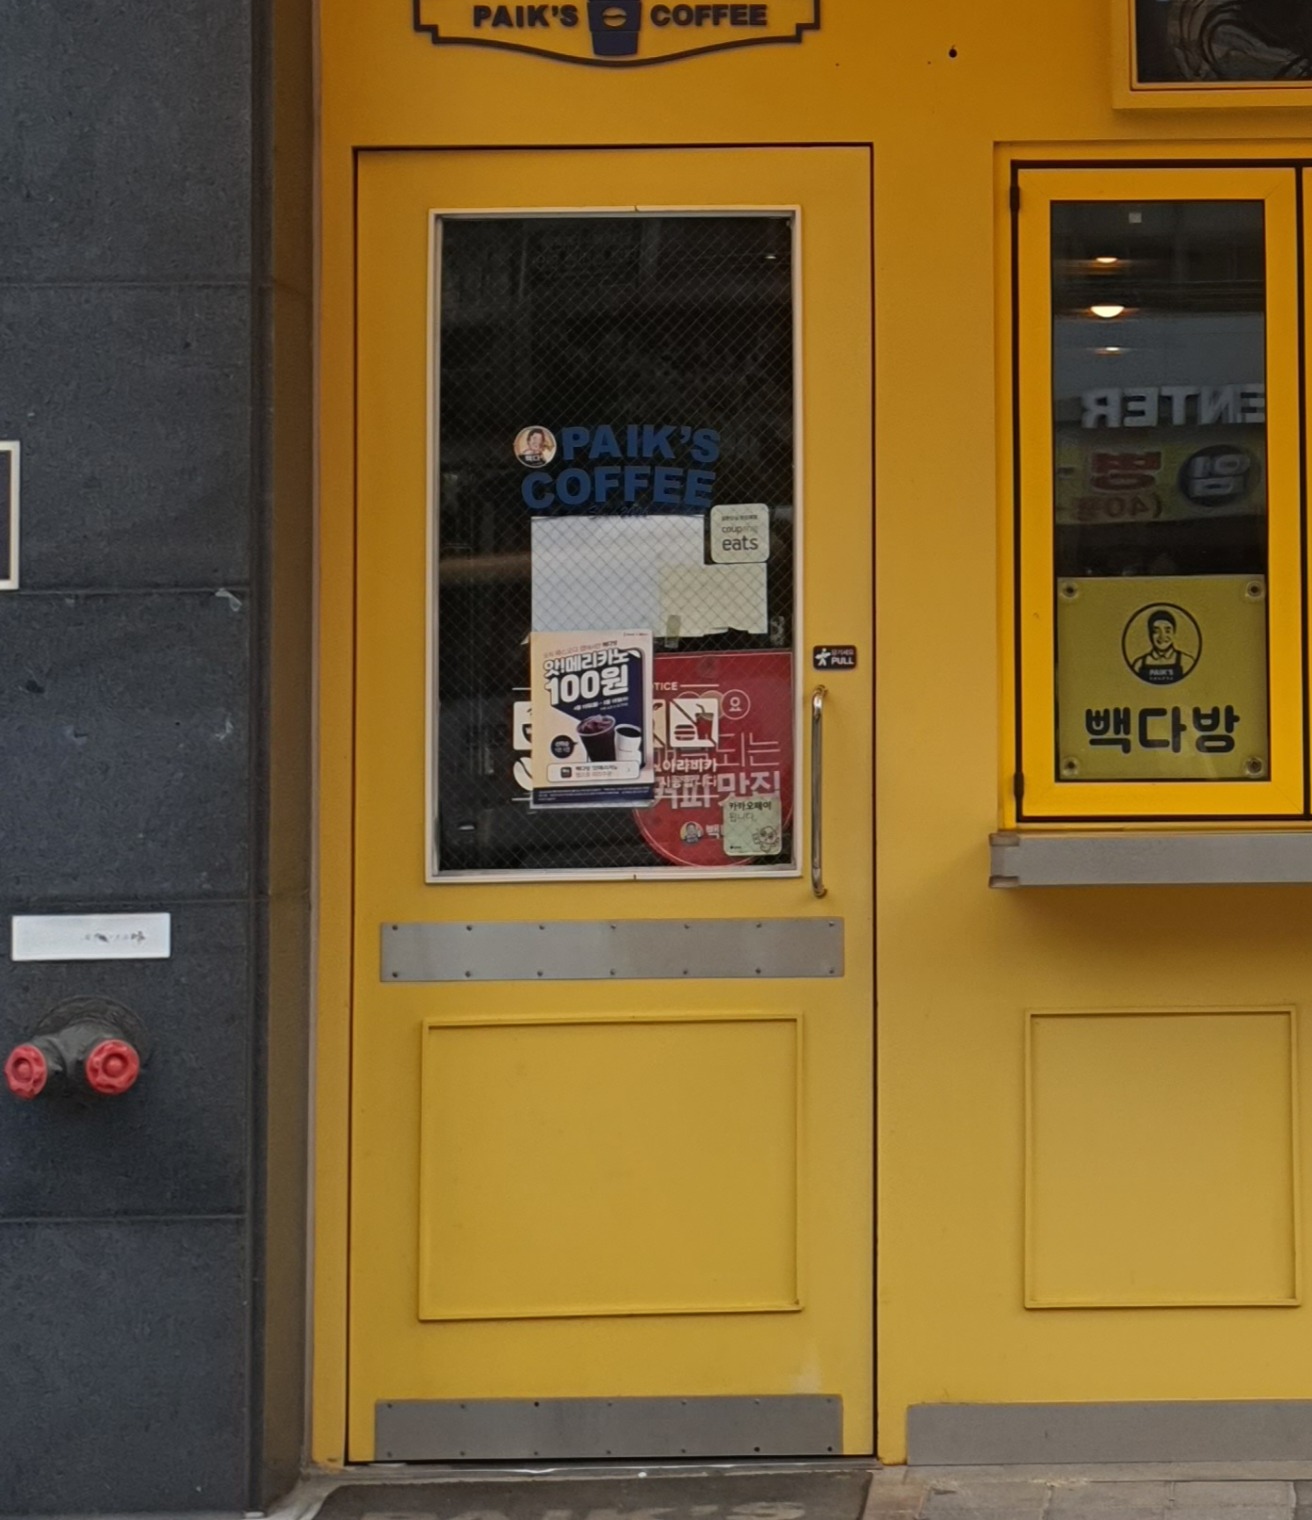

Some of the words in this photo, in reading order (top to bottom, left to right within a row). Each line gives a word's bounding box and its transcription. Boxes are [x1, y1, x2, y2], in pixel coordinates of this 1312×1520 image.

[474, 5, 579, 28] PAIK'S
[650, 4, 768, 28] COFFEE
[561, 424, 720, 463] PAIK'S
[521, 466, 716, 509] COFFEE
[722, 535, 758, 551] eats
[543, 648, 630, 677] 앗!메리카노
[831, 657, 854, 665] PULL
[545, 664, 629, 705] 100원
[653, 682, 678, 691] TICE
[1085, 705, 1240, 754] 빽다방
